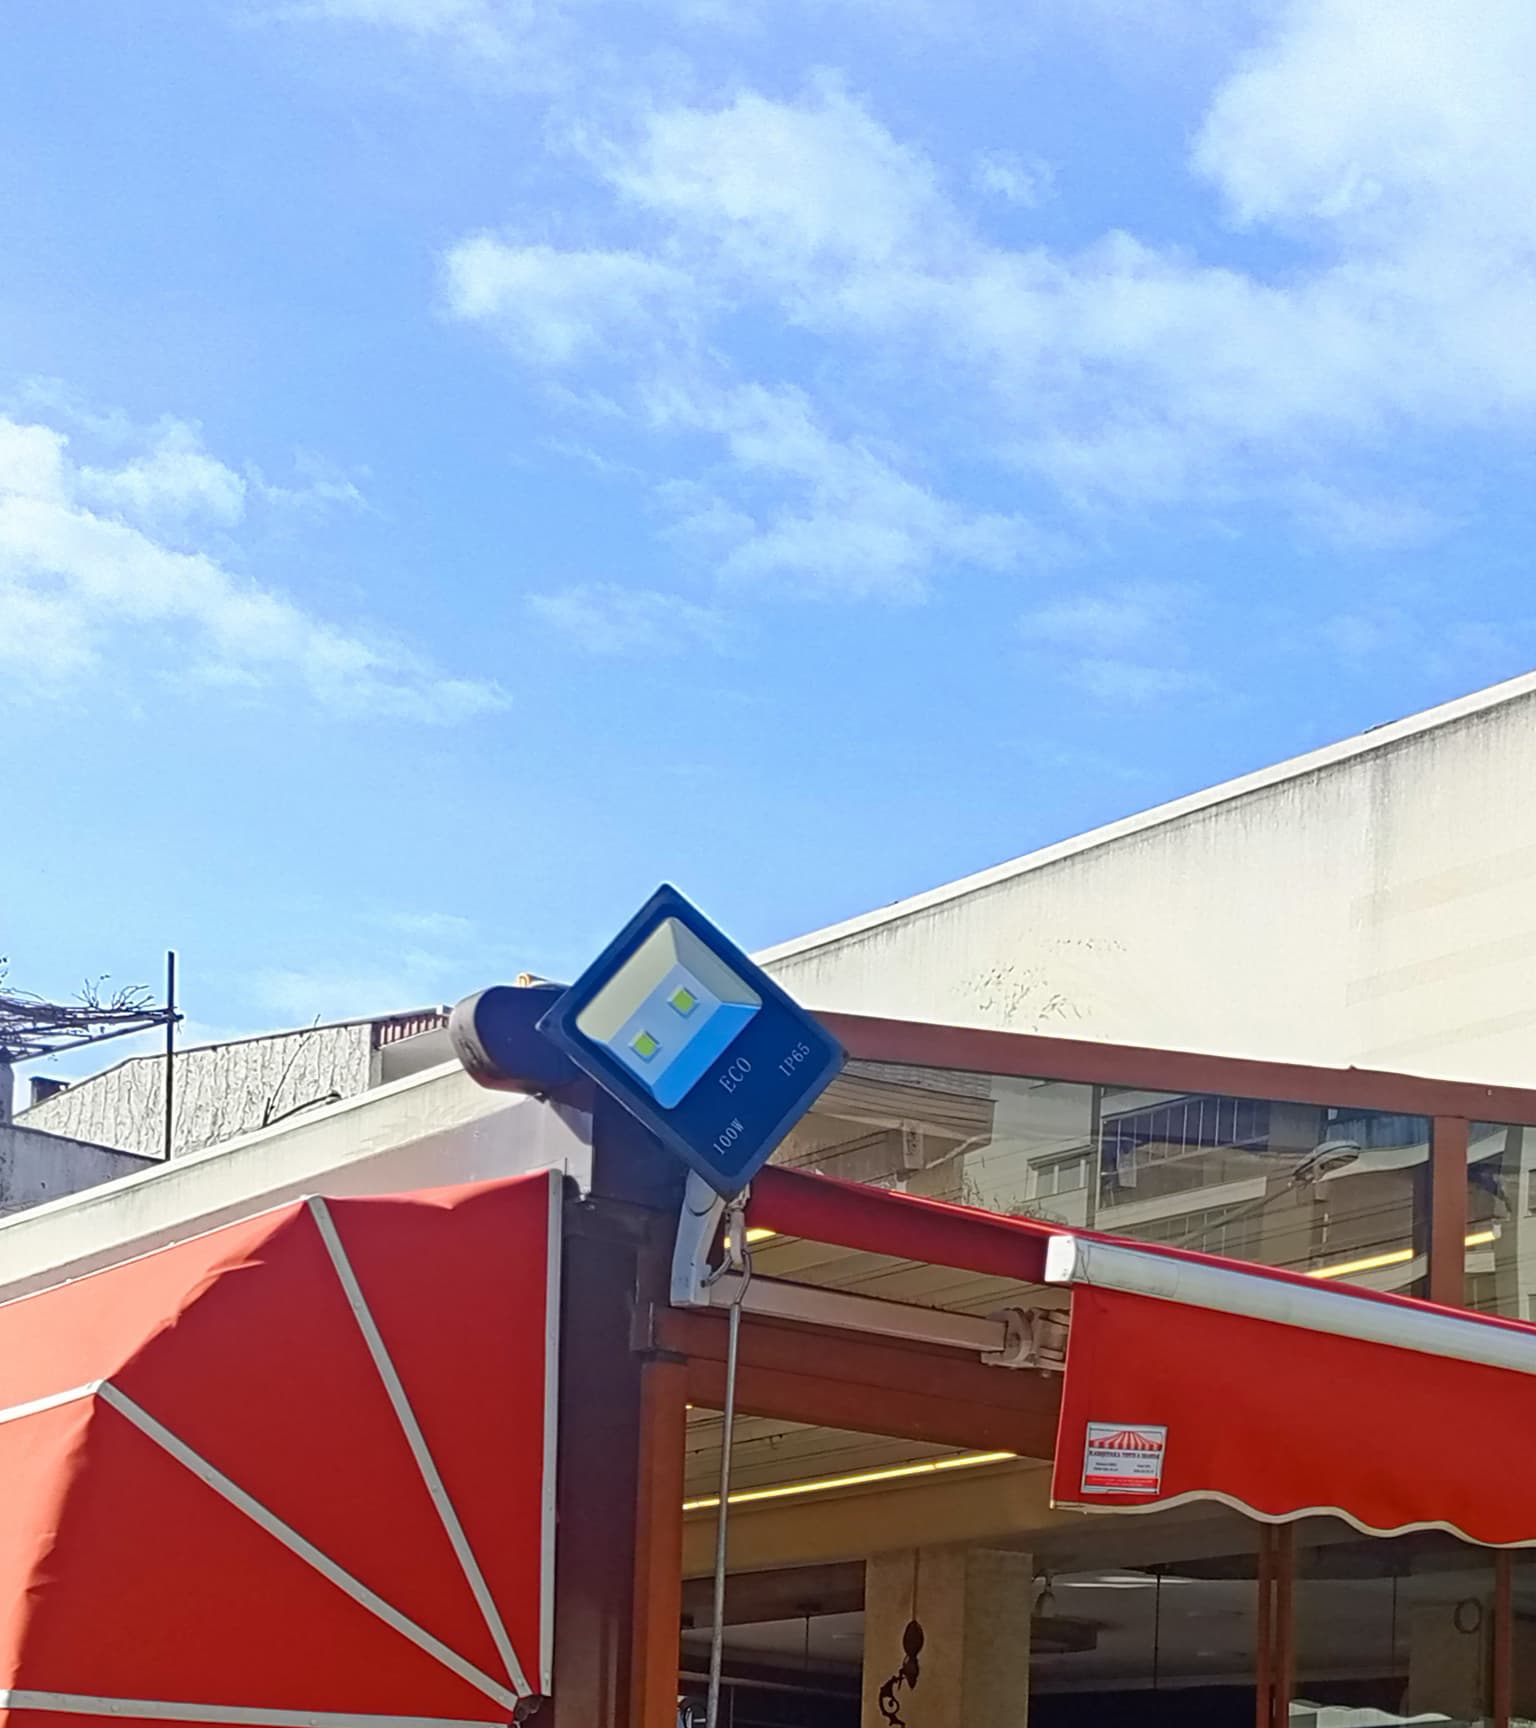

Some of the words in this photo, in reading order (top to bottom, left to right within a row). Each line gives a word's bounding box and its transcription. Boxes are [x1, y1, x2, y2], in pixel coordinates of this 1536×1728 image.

[719, 1056, 752, 1093] ECO
[778, 1041, 810, 1077] IP65
[712, 1117, 744, 1155] 100W
